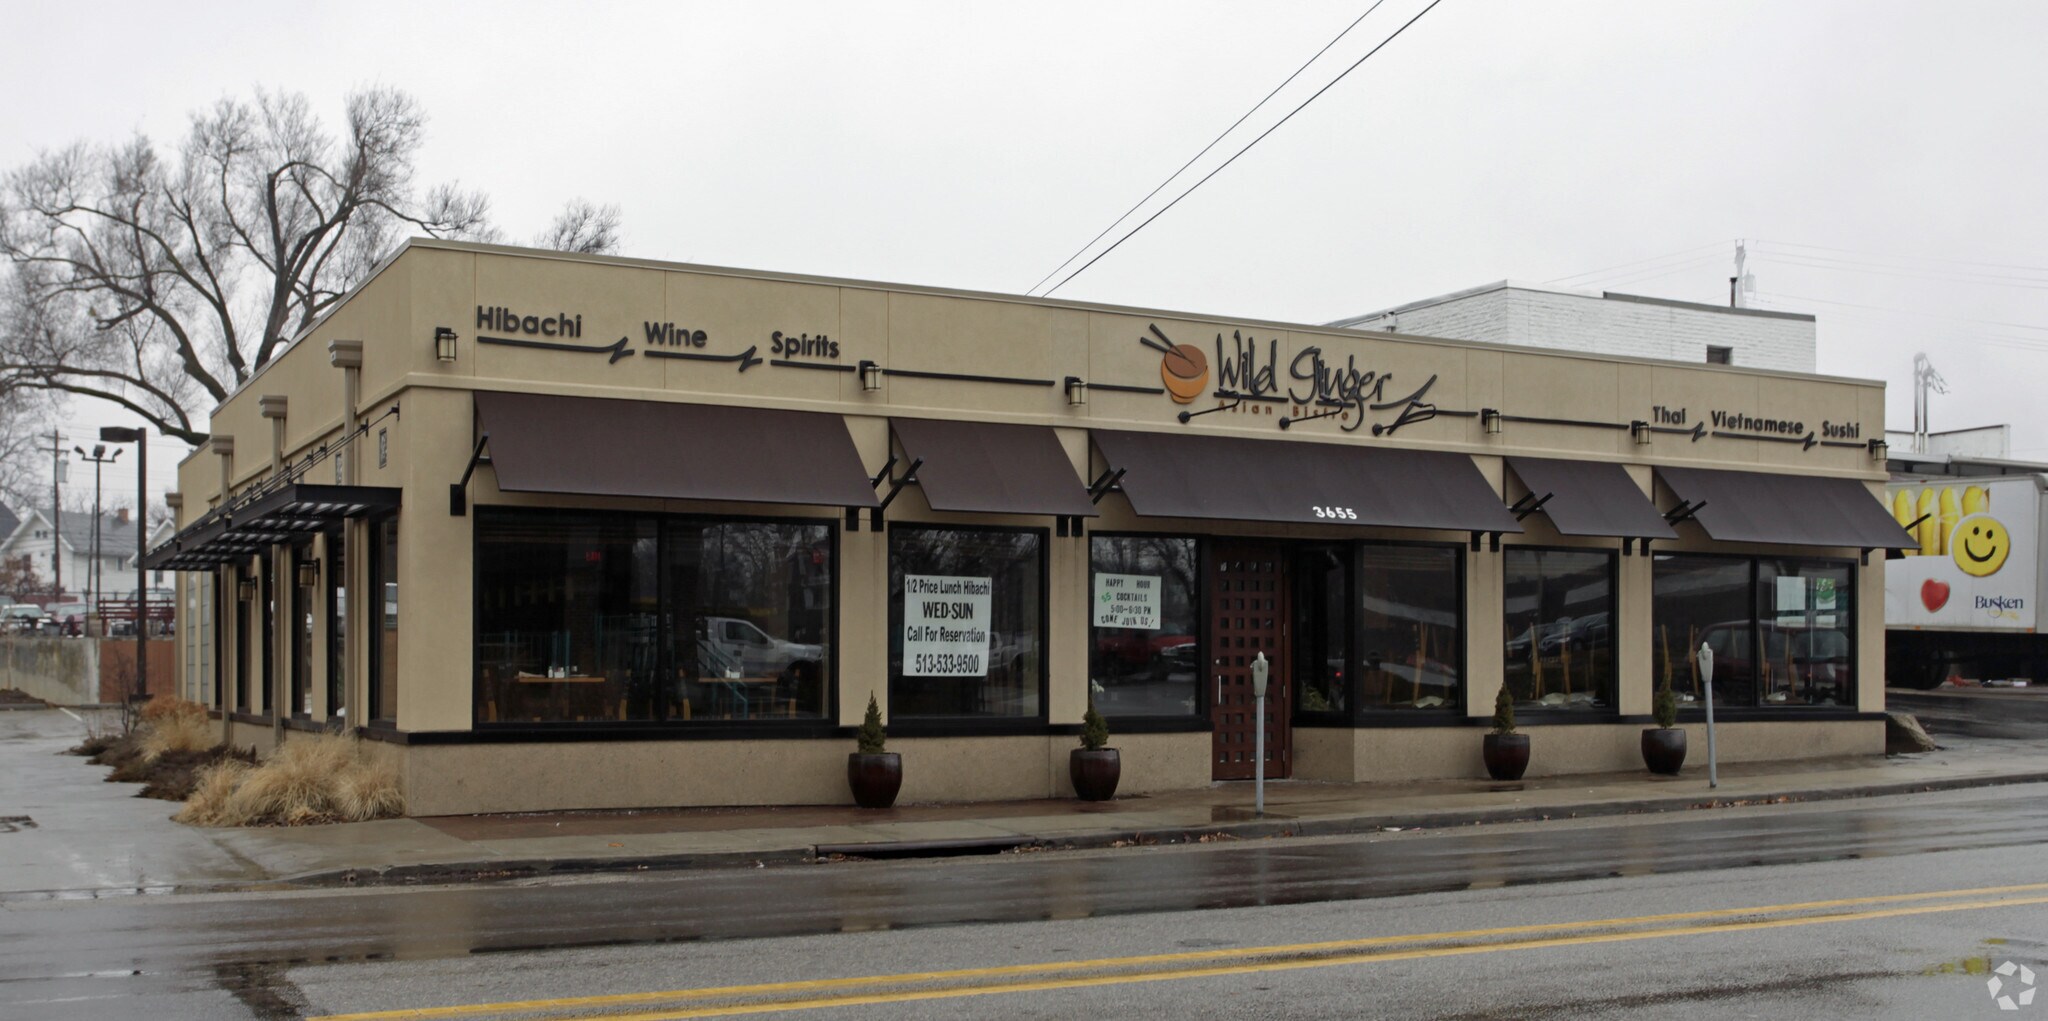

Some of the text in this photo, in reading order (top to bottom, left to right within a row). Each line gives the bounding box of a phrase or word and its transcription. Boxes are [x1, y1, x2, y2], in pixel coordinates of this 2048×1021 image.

[476, 305, 582, 339] Hibachi
[644, 321, 708, 348] Wine
[771, 331, 840, 360] Spirits
[1216, 329, 1393, 432] Wild Ginger
[1218, 400, 1349, 421] Asian Bistro
[1652, 405, 1686, 425] Thai
[1711, 410, 1804, 435] Vietnamese
[1822, 420, 1860, 439] Sushi
[1312, 506, 1357, 520] 3655
[906, 578, 990, 596] 1/2 Price Lunch Hibachi
[1105, 578, 1151, 589] HAPPY HOUR
[1116, 592, 1148, 602] COCKTAILS
[1975, 595, 2024, 618] Busken
[1101, 614, 1118, 624] COME
[1121, 617, 1137, 626] JOIN
[907, 625, 986, 643] Call For Reservation
[916, 653, 980, 673] 513-533-9500
